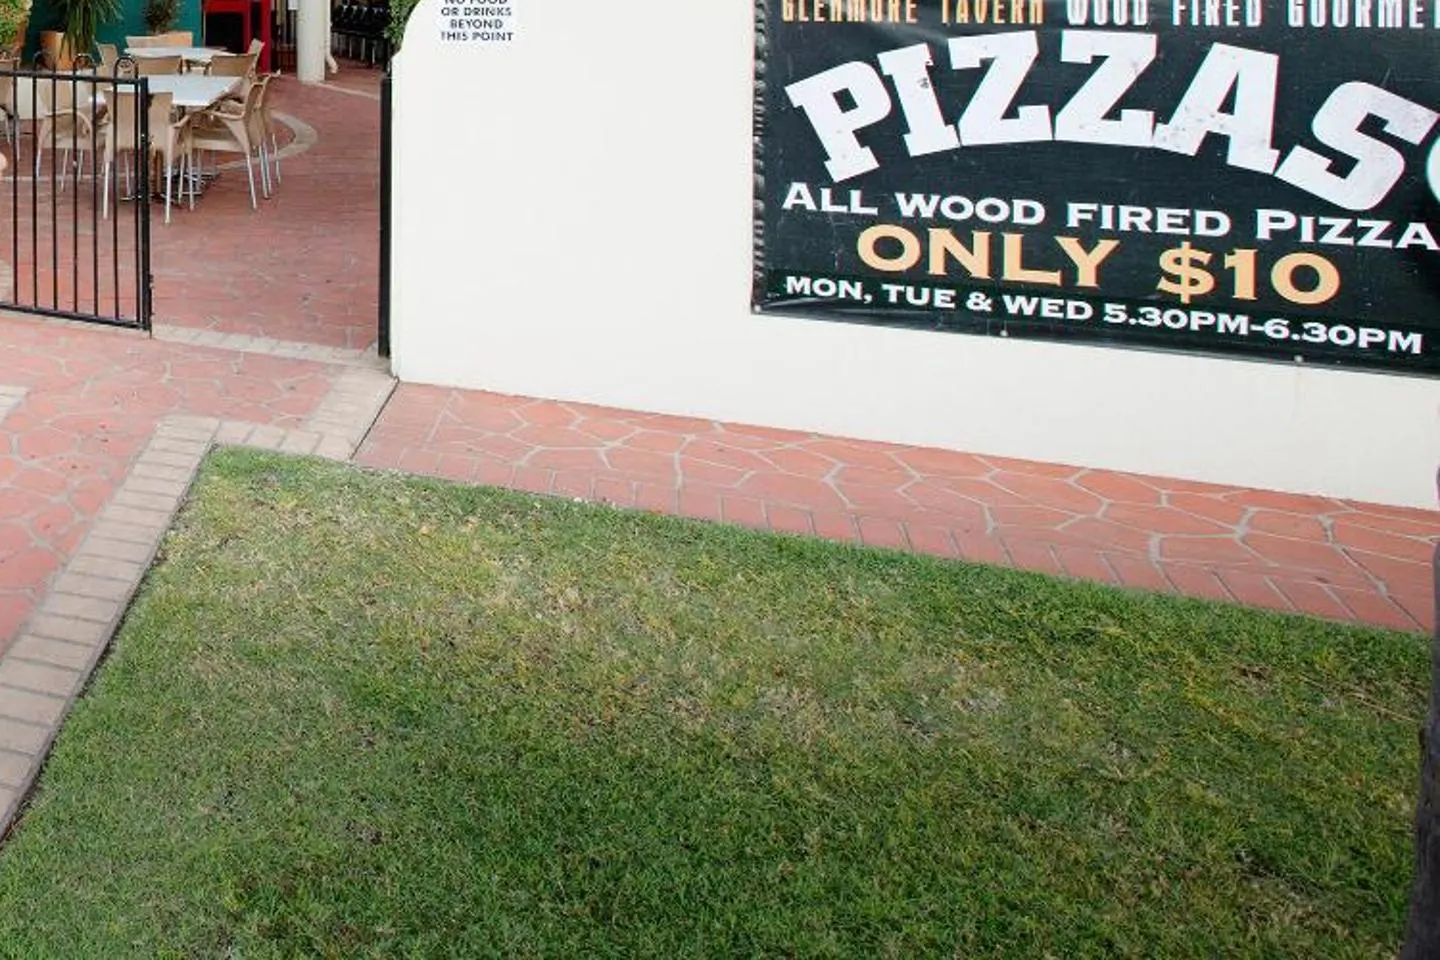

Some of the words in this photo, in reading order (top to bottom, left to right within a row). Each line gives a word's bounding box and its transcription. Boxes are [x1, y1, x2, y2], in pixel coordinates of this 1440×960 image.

[441, 7, 460, 16] OR
[463, 7, 513, 17] DRINKS
[441, 31, 469, 41] THIS
[471, 31, 514, 41] POINT
[450, 19, 504, 29] BEYOND
[784, 30, 1440, 211] PIZZAS
[781, 181, 879, 216] ALL
[895, 192, 1046, 225] WOOD
[1066, 202, 1232, 238] FIRED
[856, 223, 1121, 289] ONLY
[1157, 241, 1341, 305] $10
[786, 275, 873, 305] MON,
[882, 283, 957, 309] TUE
[965, 290, 993, 312] &
[1001, 294, 1094, 321] WED
[1103, 302, 1424, 355] 5.30PM-6.30PM
